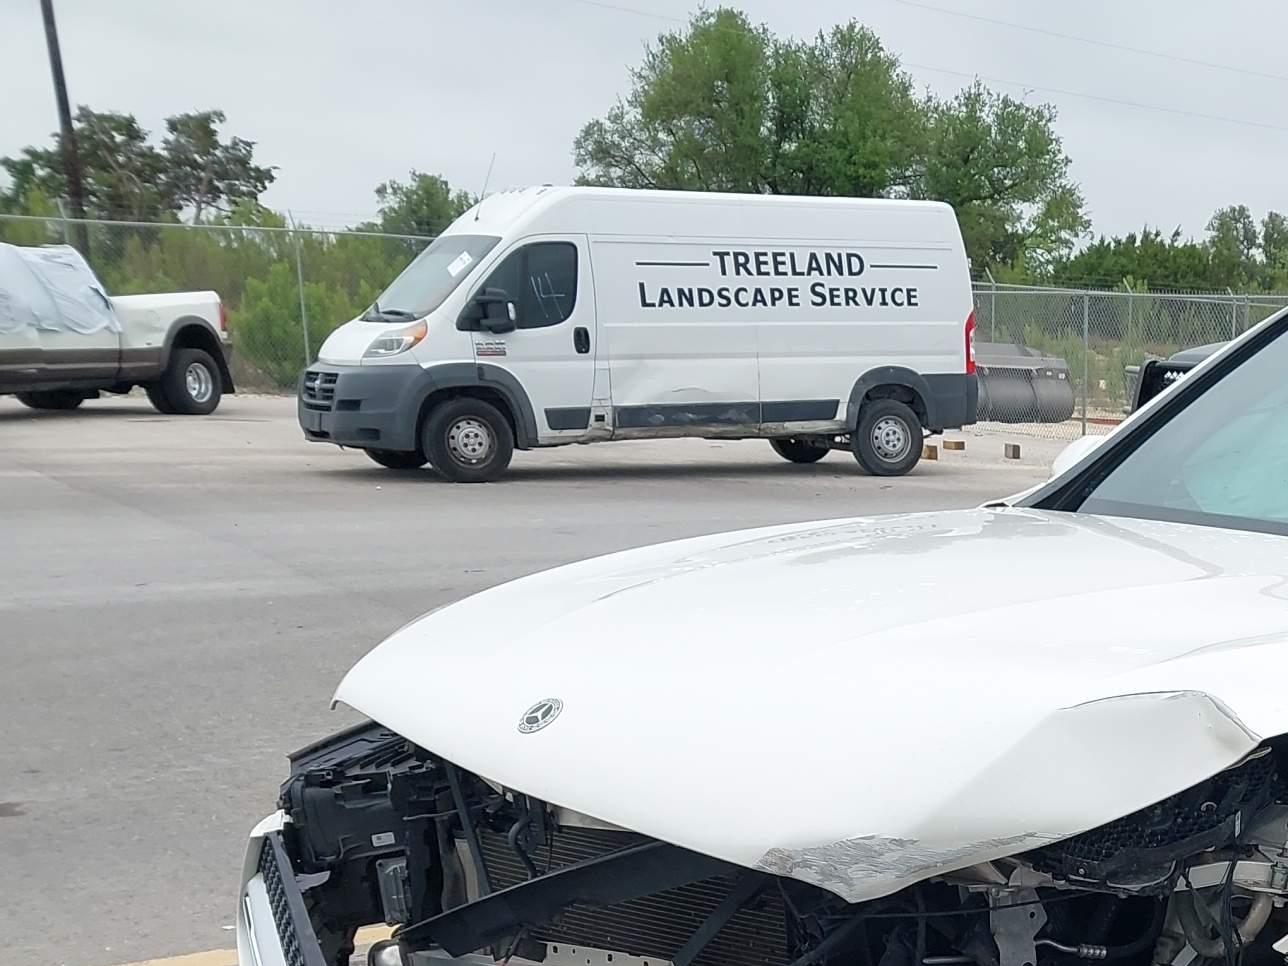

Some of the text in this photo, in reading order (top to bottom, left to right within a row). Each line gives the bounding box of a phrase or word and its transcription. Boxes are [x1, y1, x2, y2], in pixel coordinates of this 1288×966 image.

[712, 250, 865, 276] TREELAND
[638, 281, 919, 307] LANDSCAPE SERVICE
